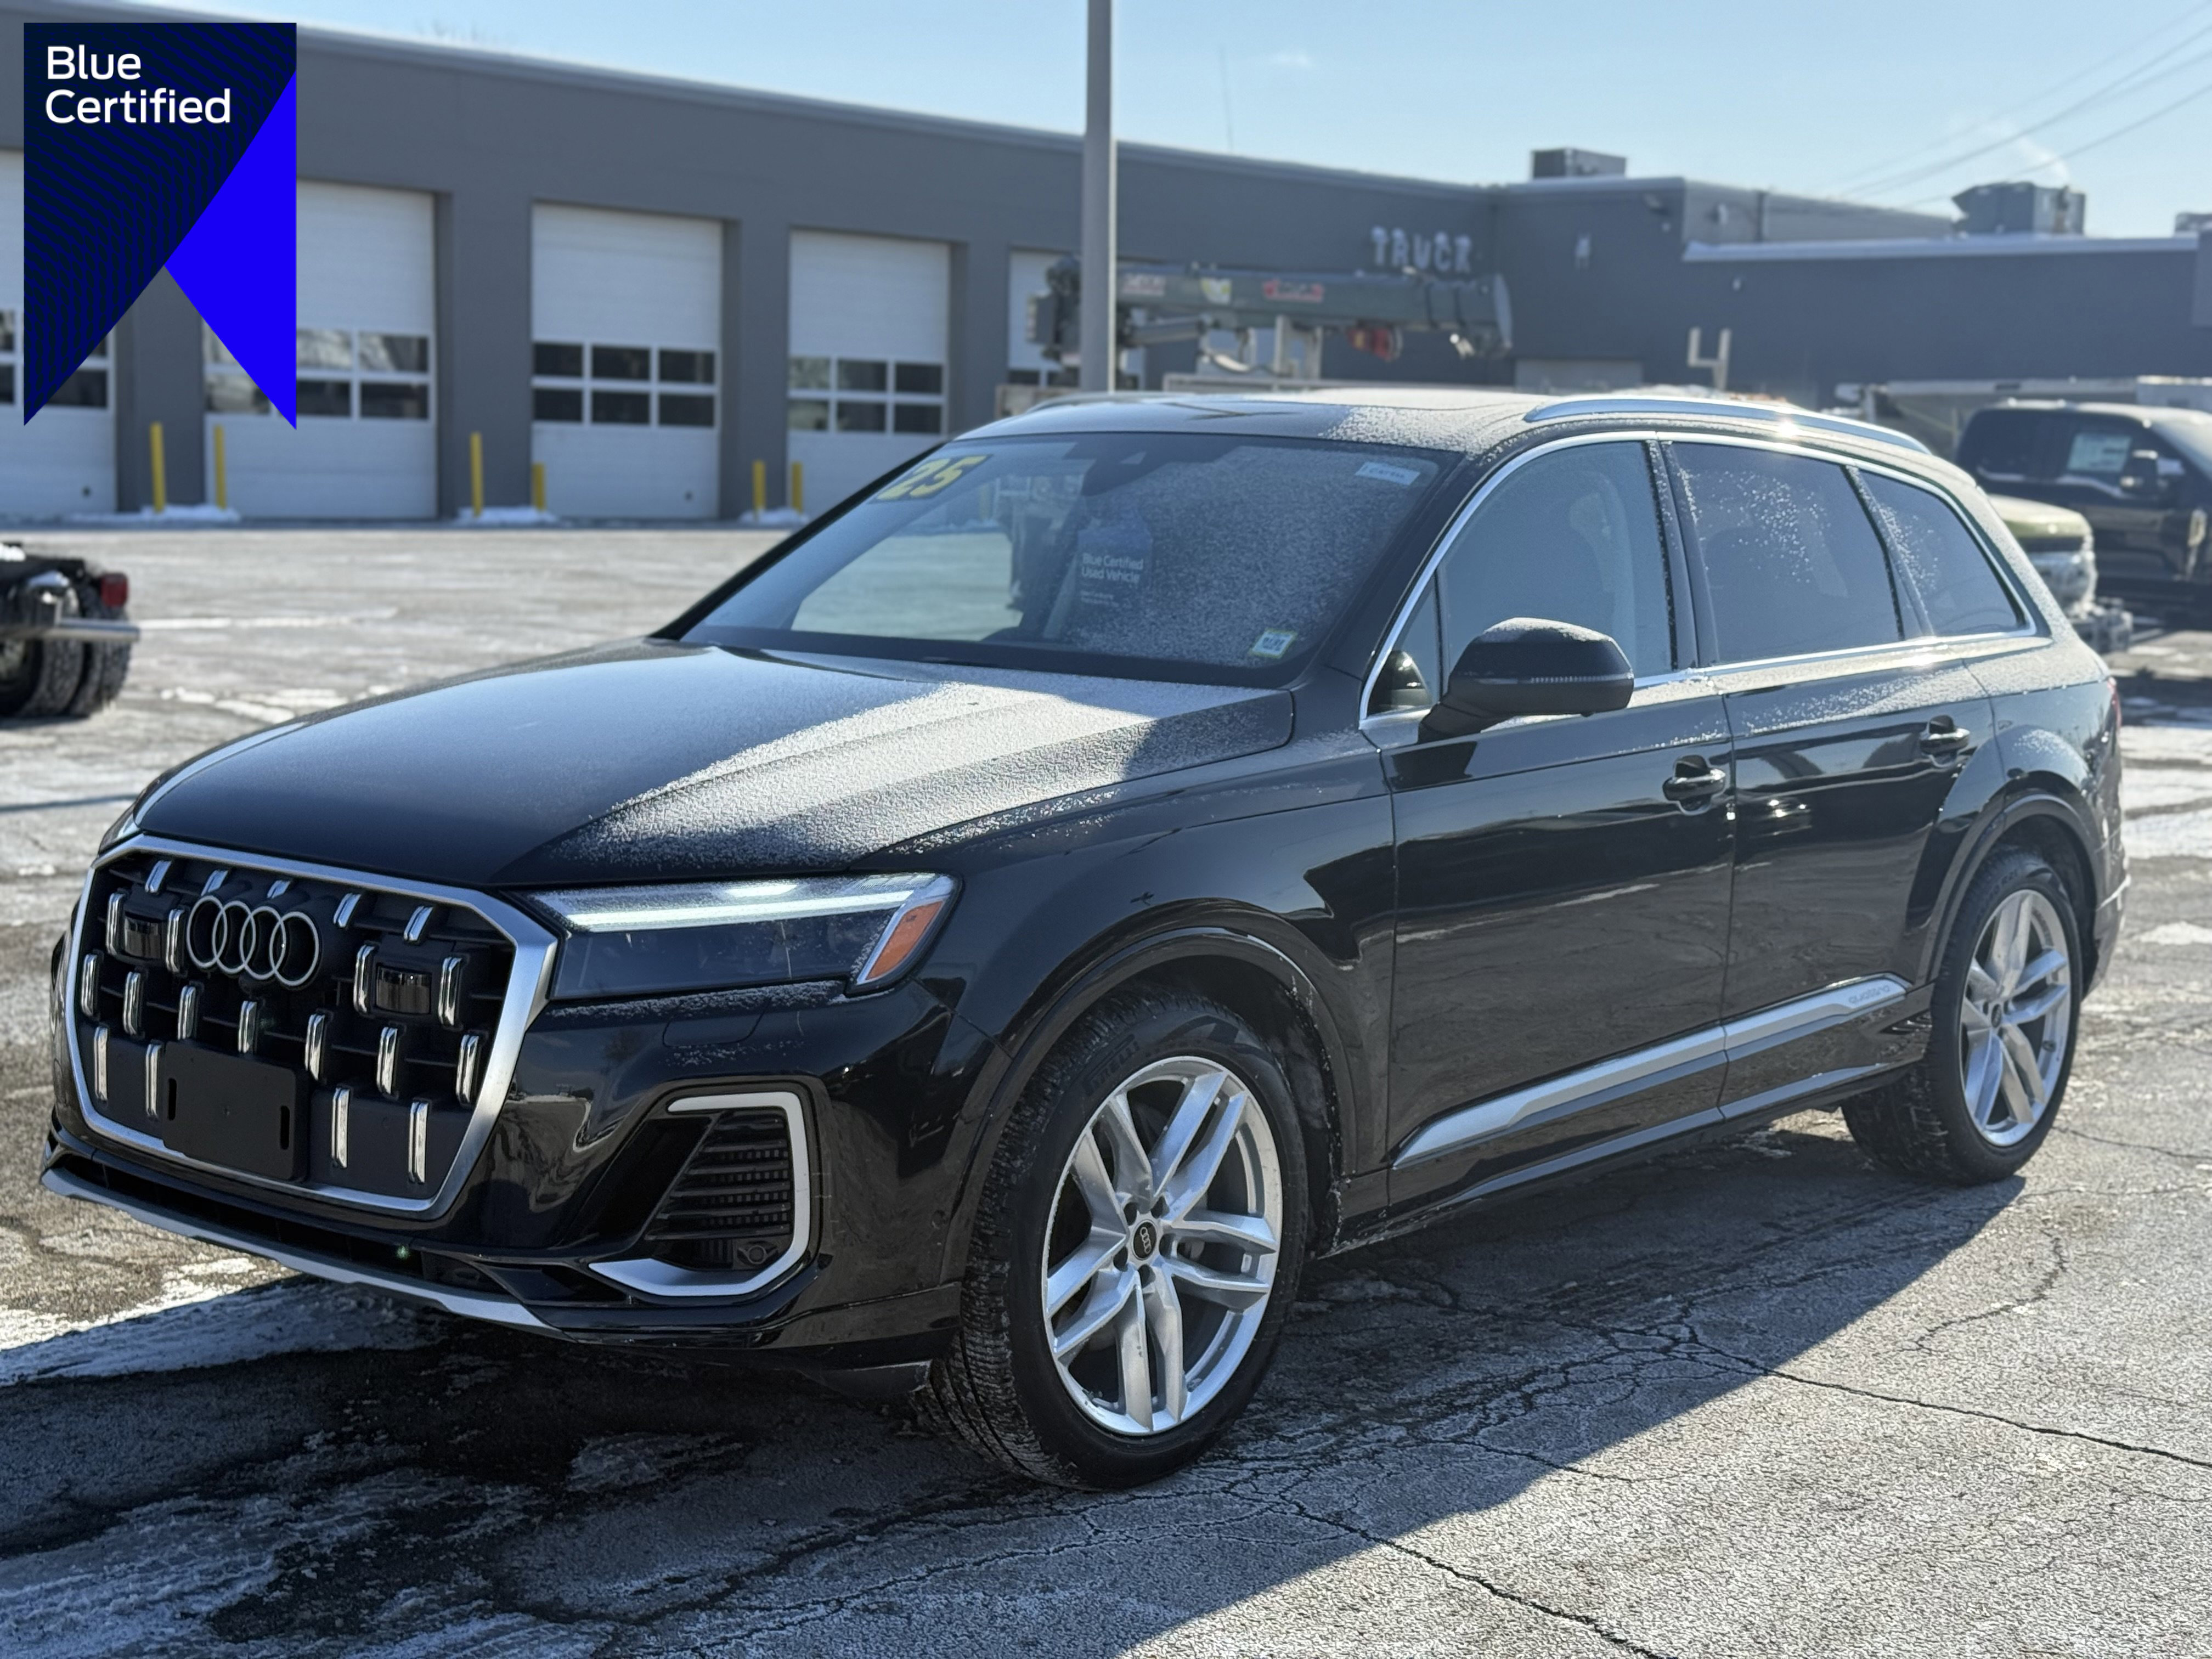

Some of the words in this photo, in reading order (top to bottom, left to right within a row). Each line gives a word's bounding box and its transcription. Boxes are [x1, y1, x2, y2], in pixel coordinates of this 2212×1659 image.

[1372, 226, 1471, 273] TRUCK
[876, 455, 988, 500] 25
[1081, 566, 1104, 579] Used
